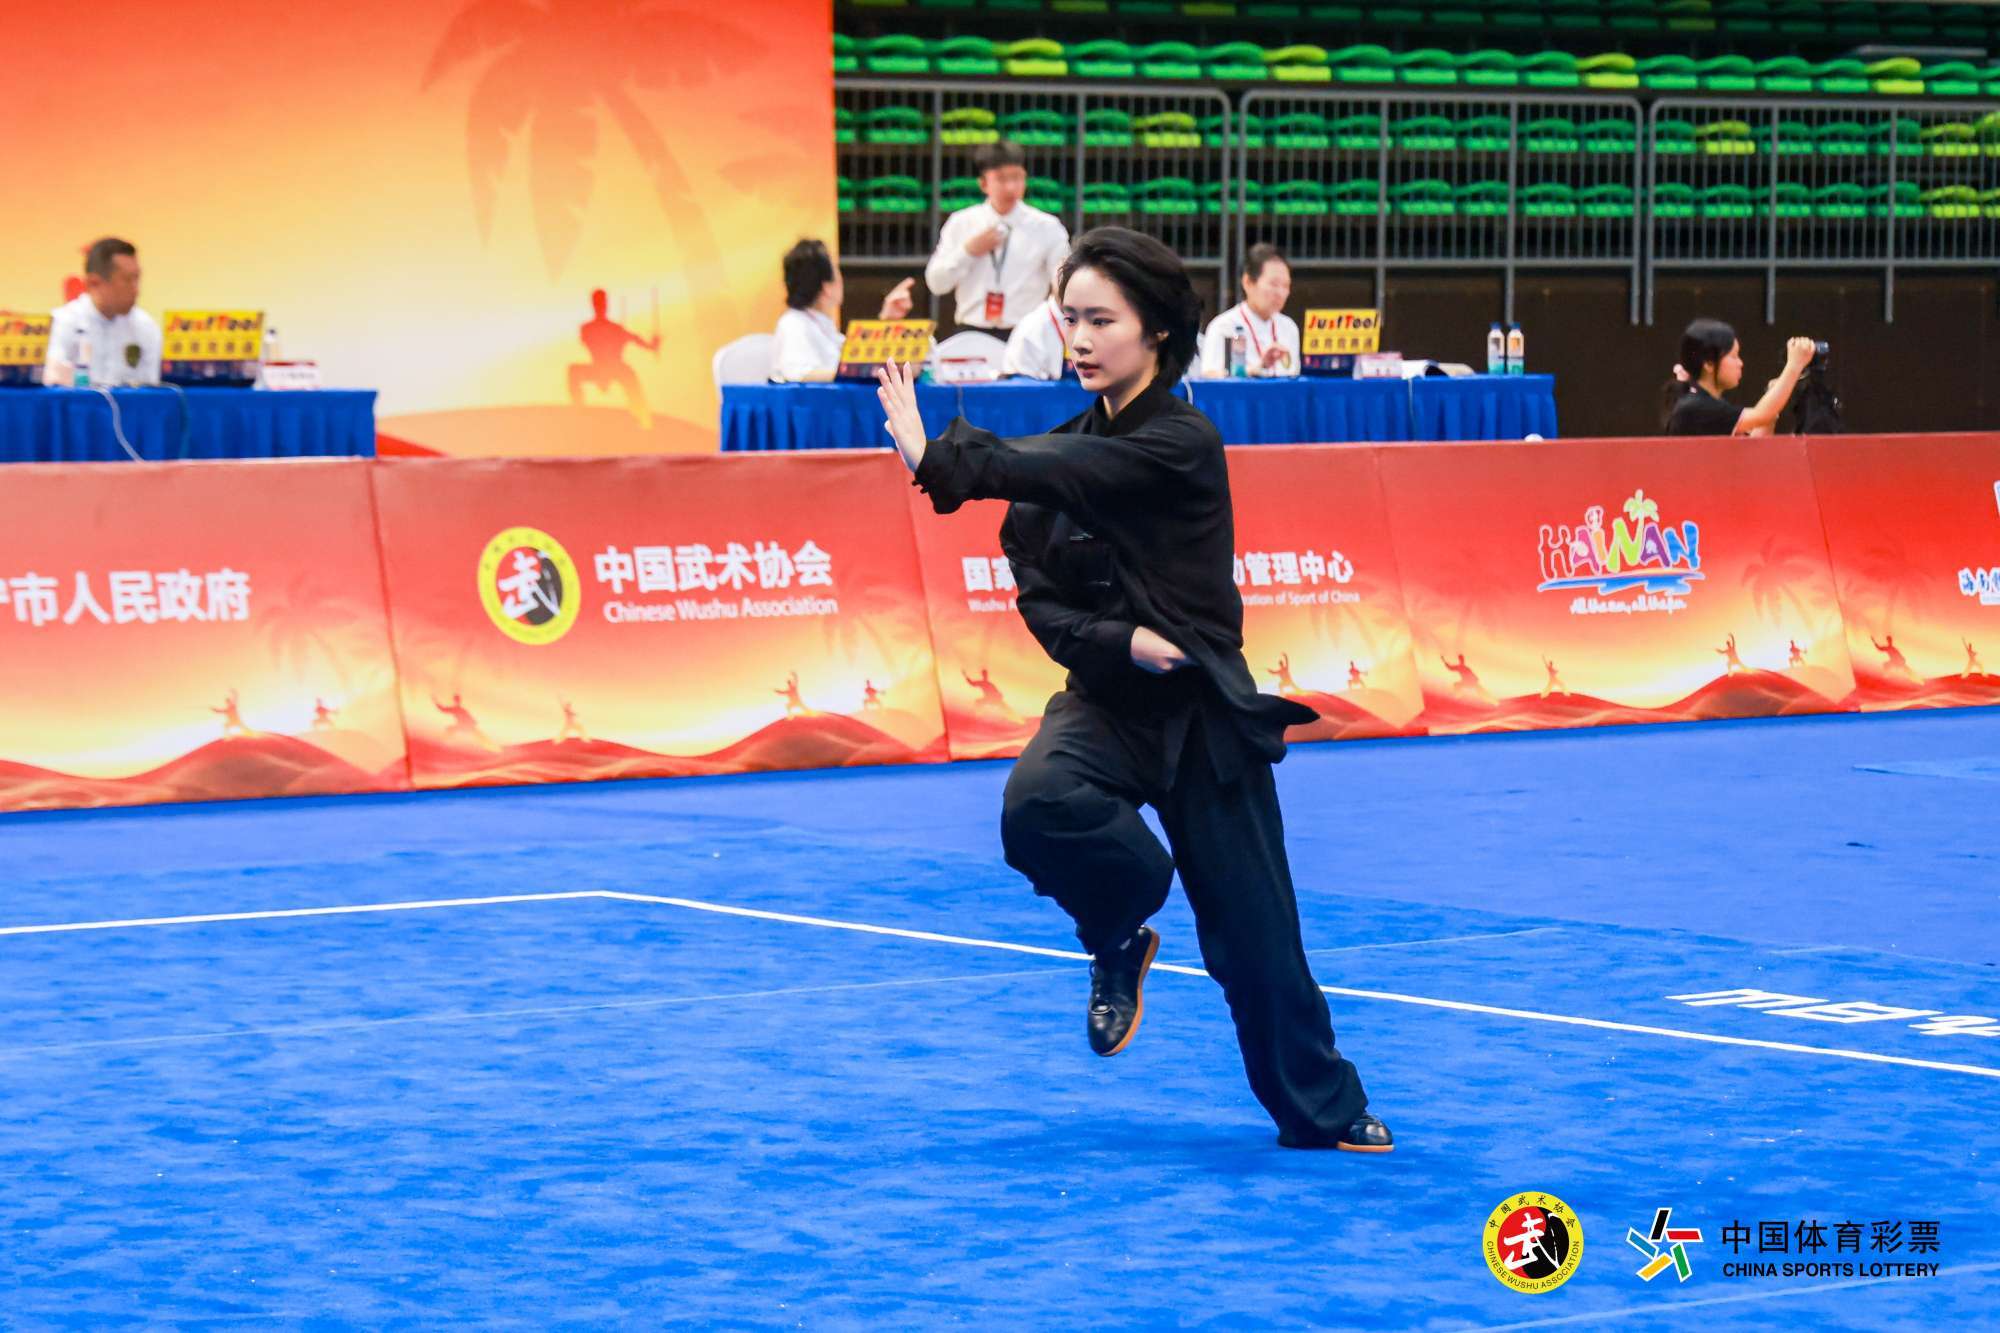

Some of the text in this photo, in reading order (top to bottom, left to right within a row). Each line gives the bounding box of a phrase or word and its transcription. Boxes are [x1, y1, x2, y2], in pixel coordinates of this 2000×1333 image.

[594, 540, 833, 594] 中国武术协会
[603, 595, 838, 623] Chinese Wushu Association
